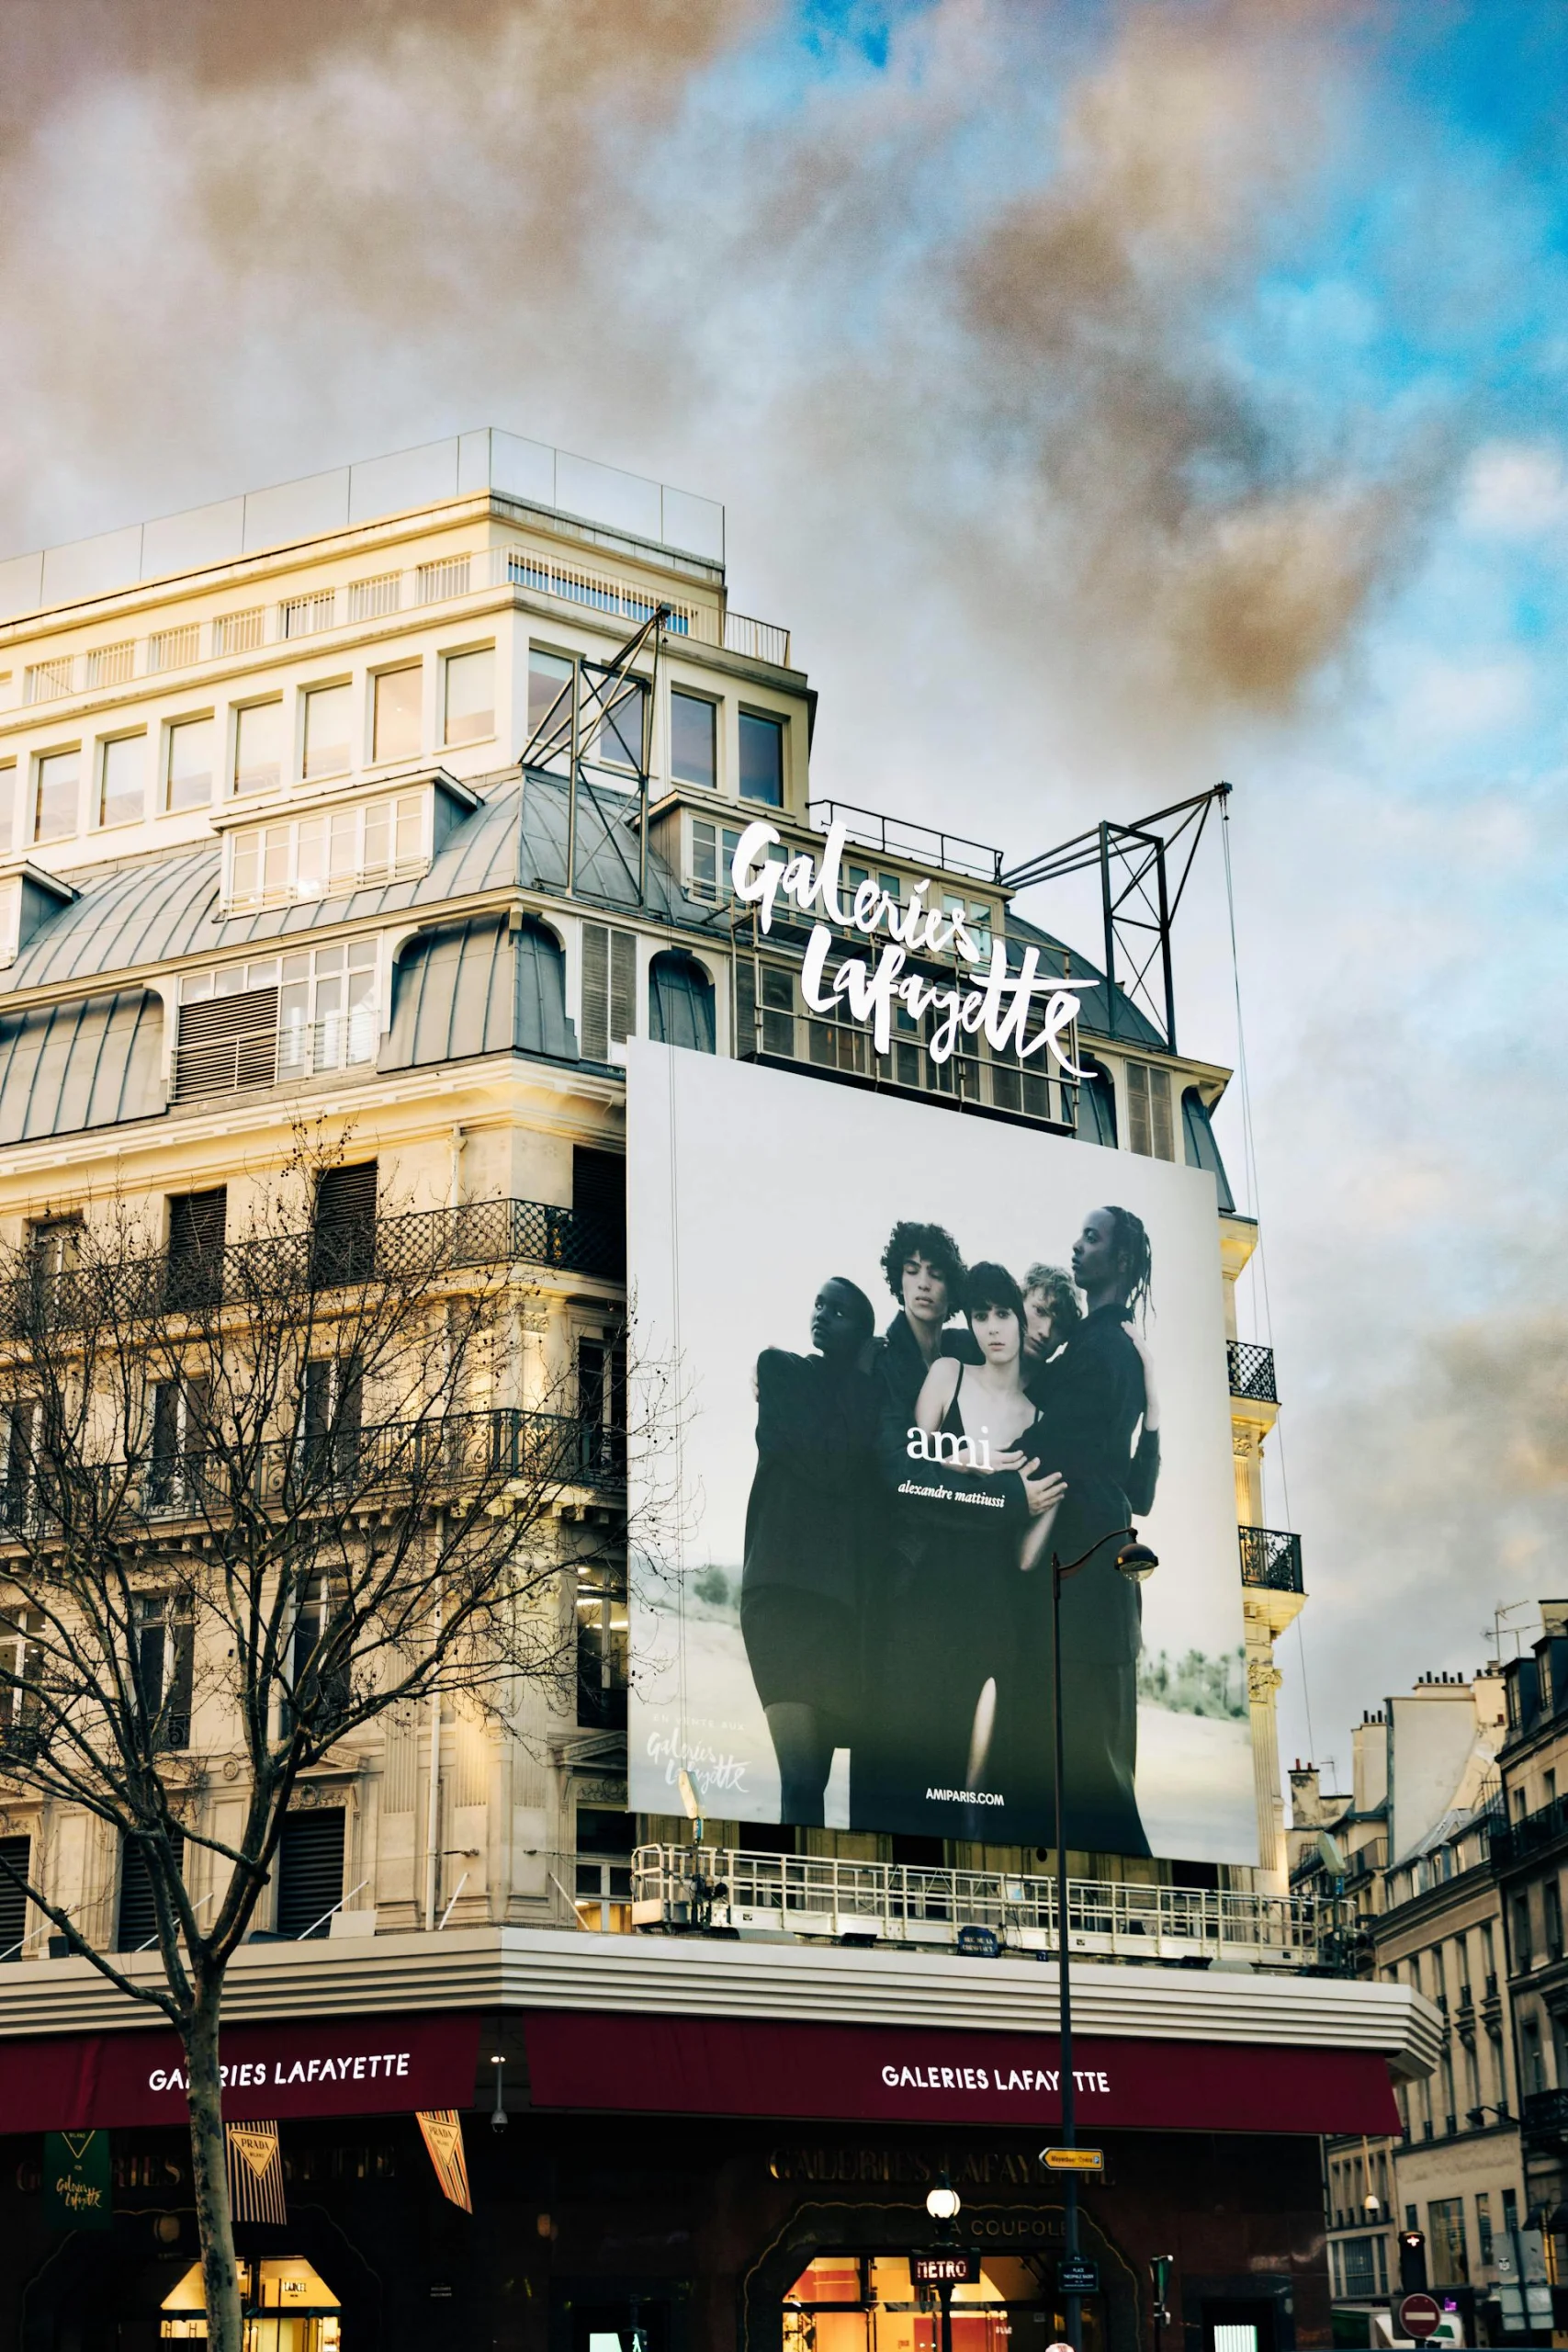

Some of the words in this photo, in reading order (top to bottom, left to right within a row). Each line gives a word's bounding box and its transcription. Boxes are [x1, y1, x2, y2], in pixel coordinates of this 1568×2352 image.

[732, 820, 980, 963] Galeries
[801, 925, 1100, 1079] Lafayette
[907, 1425, 995, 1471] ami
[897, 1480, 953, 1500] alexandre
[954, 1491, 1006, 1509] mattiussi
[647, 1727, 716, 1764] Galeries
[925, 1787, 1005, 1806] AMIPARIS.COM
[148, 2063, 266, 2091] GARIES
[275, 2052, 411, 2084] LAFAYETTE
[881, 2065, 989, 2090] GALERIES
[994, 2069, 1111, 2093] LAFAYTTE
[242, 2138, 269, 2151] PRADA
[428, 2125, 454, 2140] PRADA
[768, 2147, 930, 2182] GALERIES
